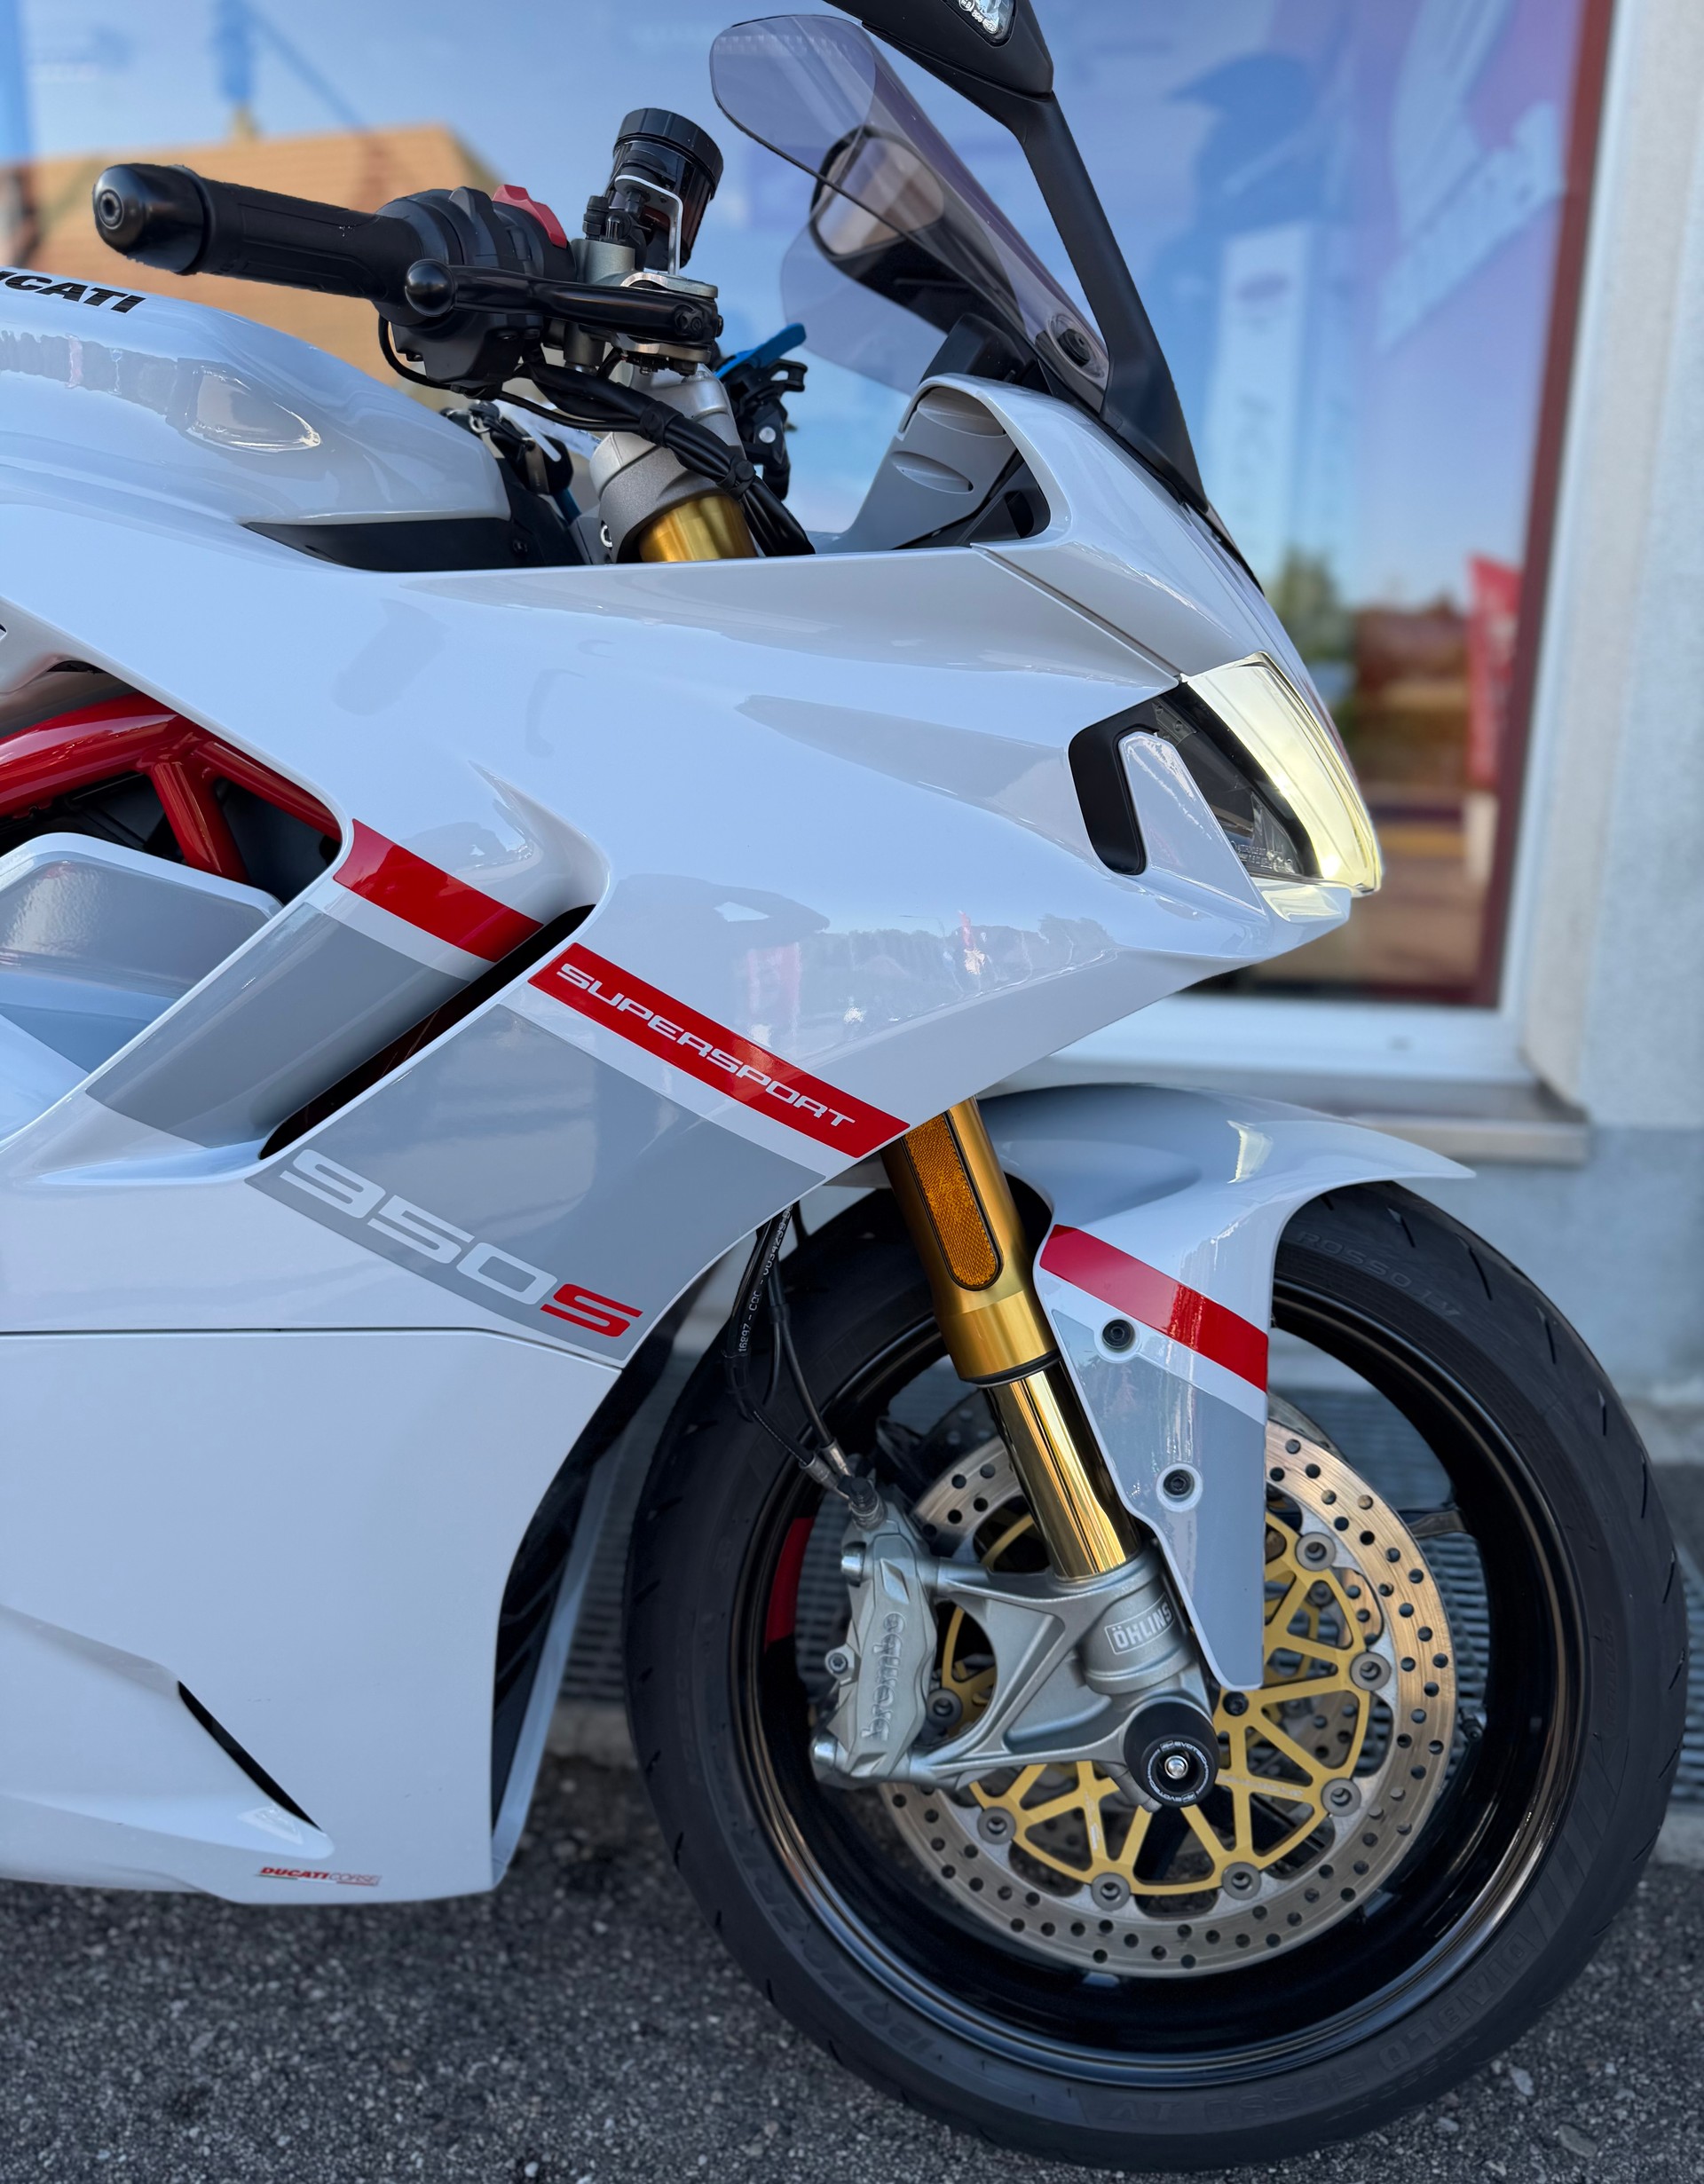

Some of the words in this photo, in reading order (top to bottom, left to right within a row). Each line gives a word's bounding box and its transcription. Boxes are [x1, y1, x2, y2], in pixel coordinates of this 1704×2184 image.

[556, 963, 856, 1127] SUPERSPORT
[1296, 1230, 1412, 1289] ROSSO
[860, 1611, 907, 1742] brembo
[1111, 1601, 1172, 1649] ÖHLINS
[1377, 1933, 1537, 2072] DIABLO
